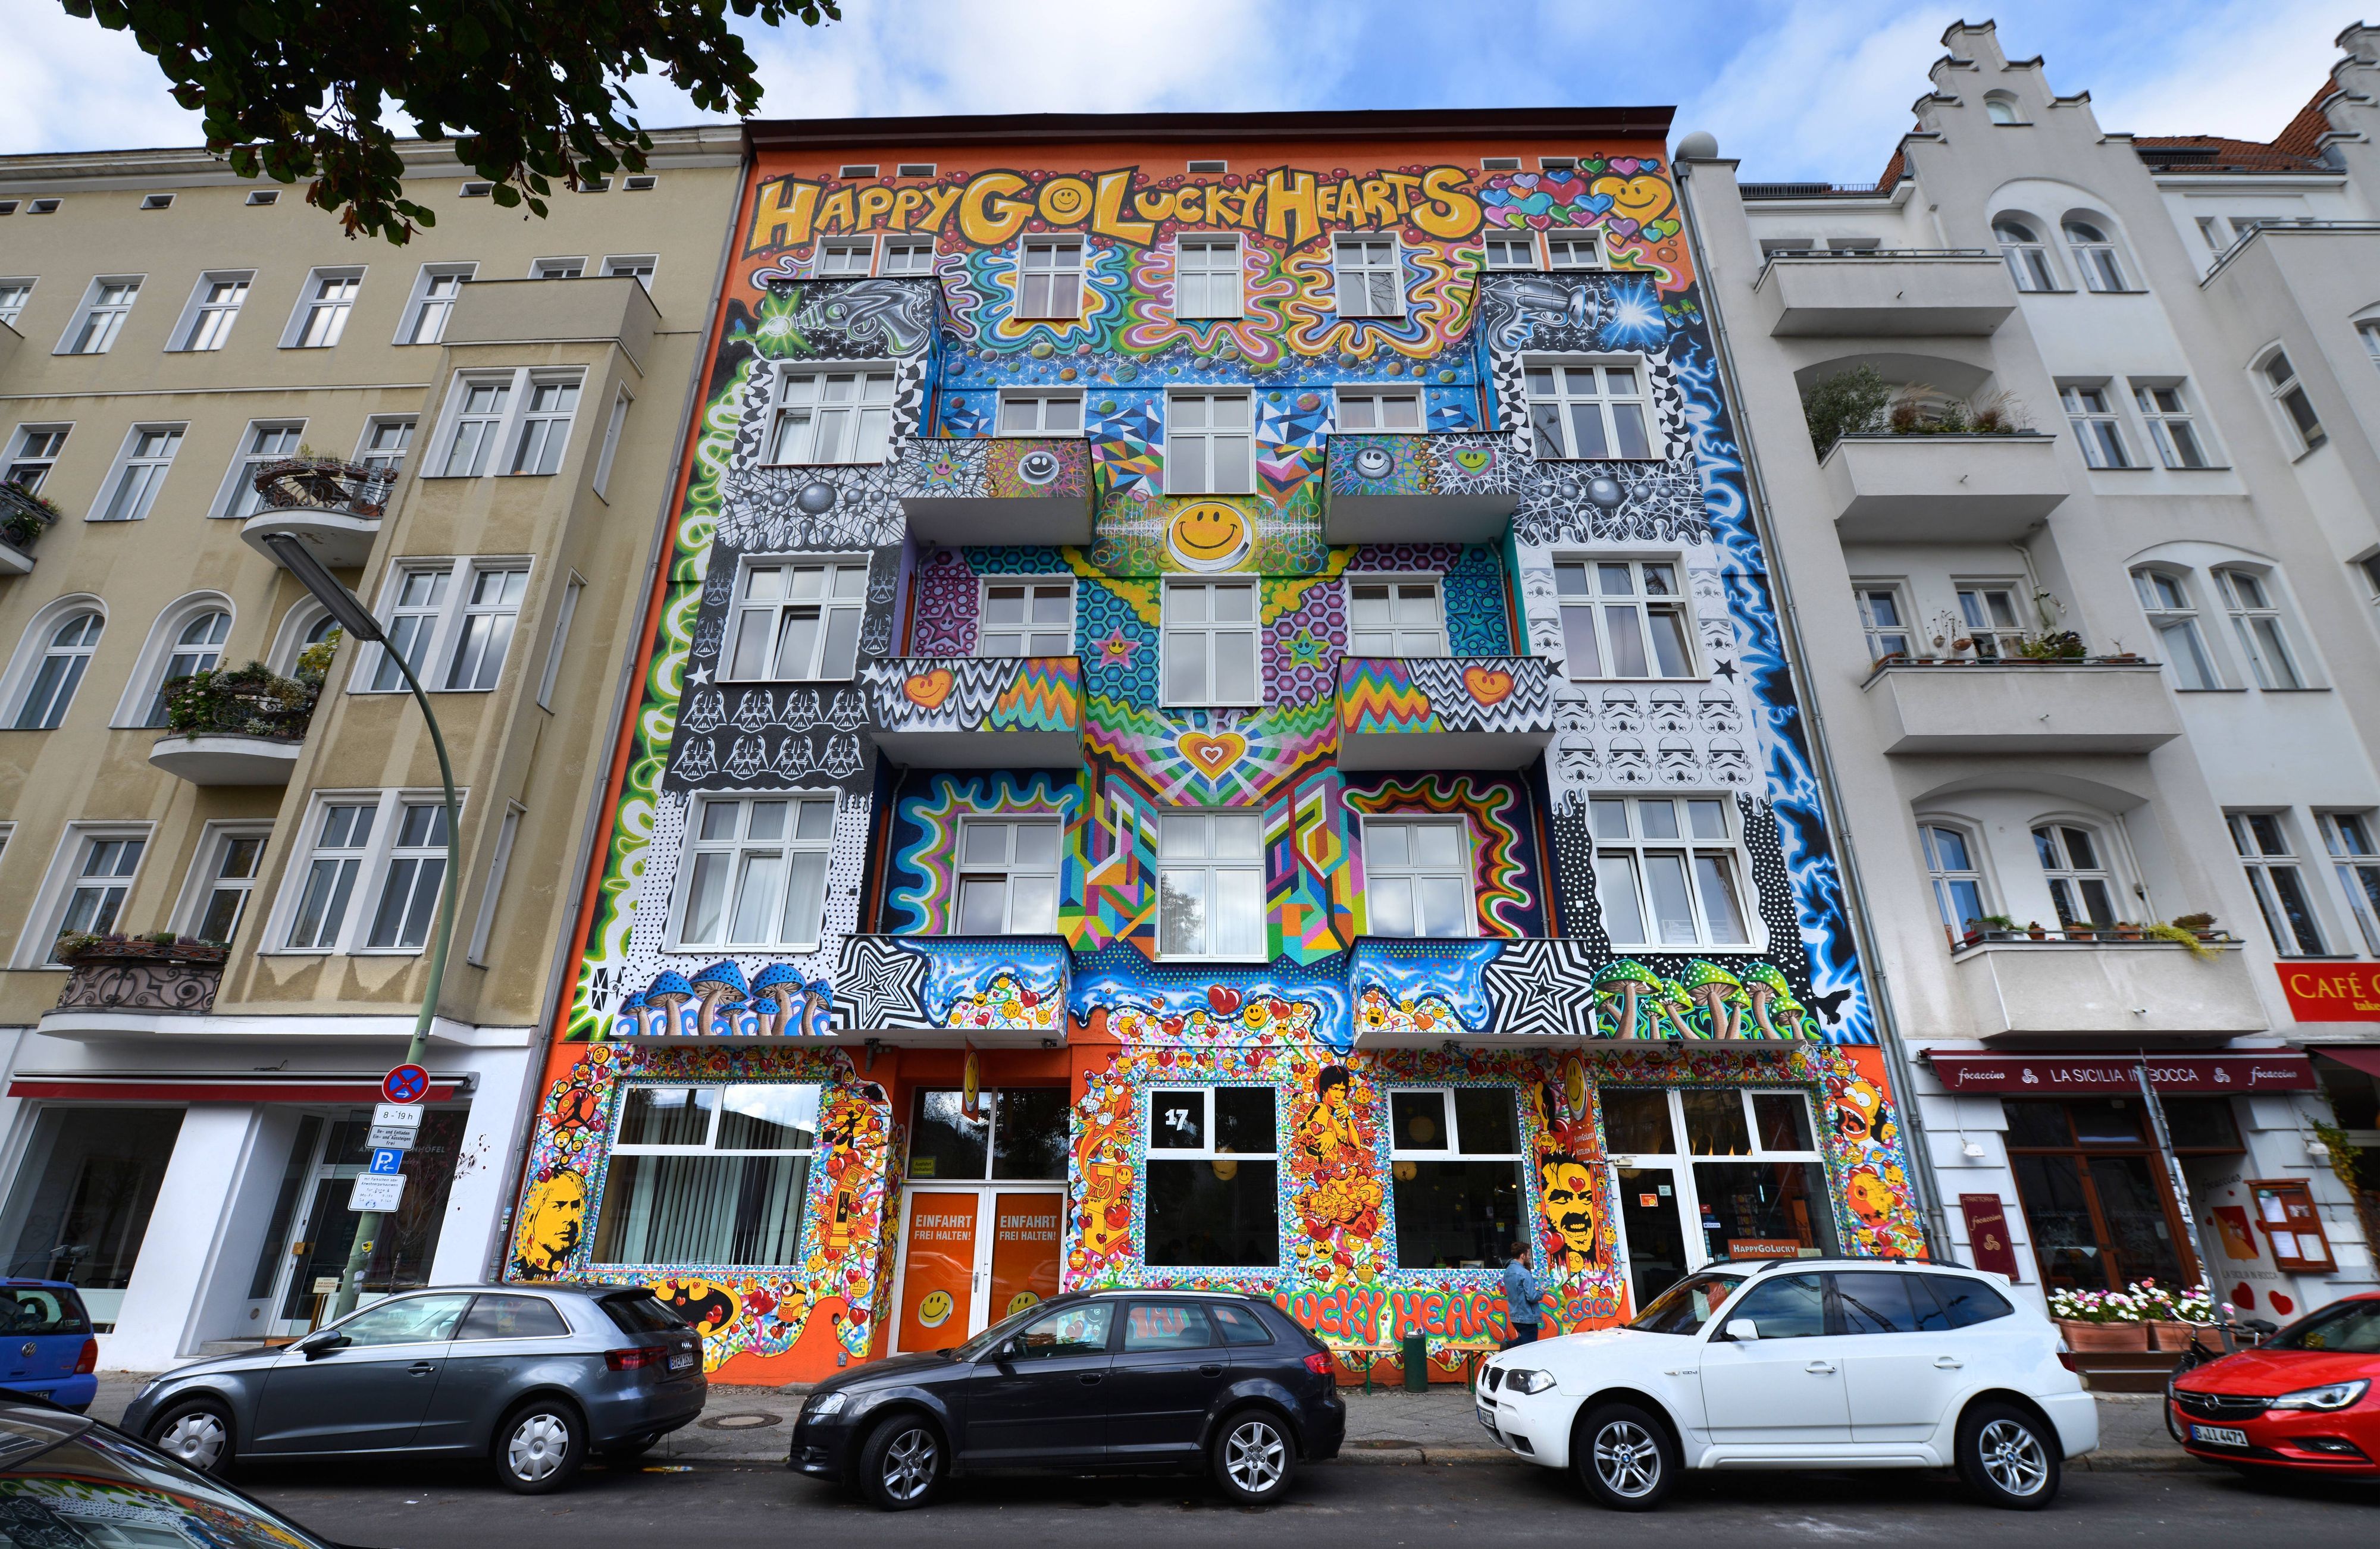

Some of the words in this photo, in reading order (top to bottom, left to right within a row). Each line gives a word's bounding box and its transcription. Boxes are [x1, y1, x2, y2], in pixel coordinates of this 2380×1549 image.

[2291, 972, 2366, 998] CAFÉ
[1955, 1068, 2005, 1087] focaccino
[2050, 1070, 2072, 1082] LA
[2072, 1069, 2125, 1082] SICILIA
[2248, 1066, 2298, 1086] focaccino
[1165, 1109, 1189, 1131] 17
[915, 1215, 973, 1228] EINFAHRT
[1000, 1215, 1057, 1228] EINFAHRT
[915, 1230, 934, 1240] FREI
[936, 1231, 971, 1241] HALTEN!
[1000, 1231, 1019, 1241] FREI
[1021, 1231, 1057, 1241] HALTEN!
[2220, 1429, 2247, 1445] 4471
